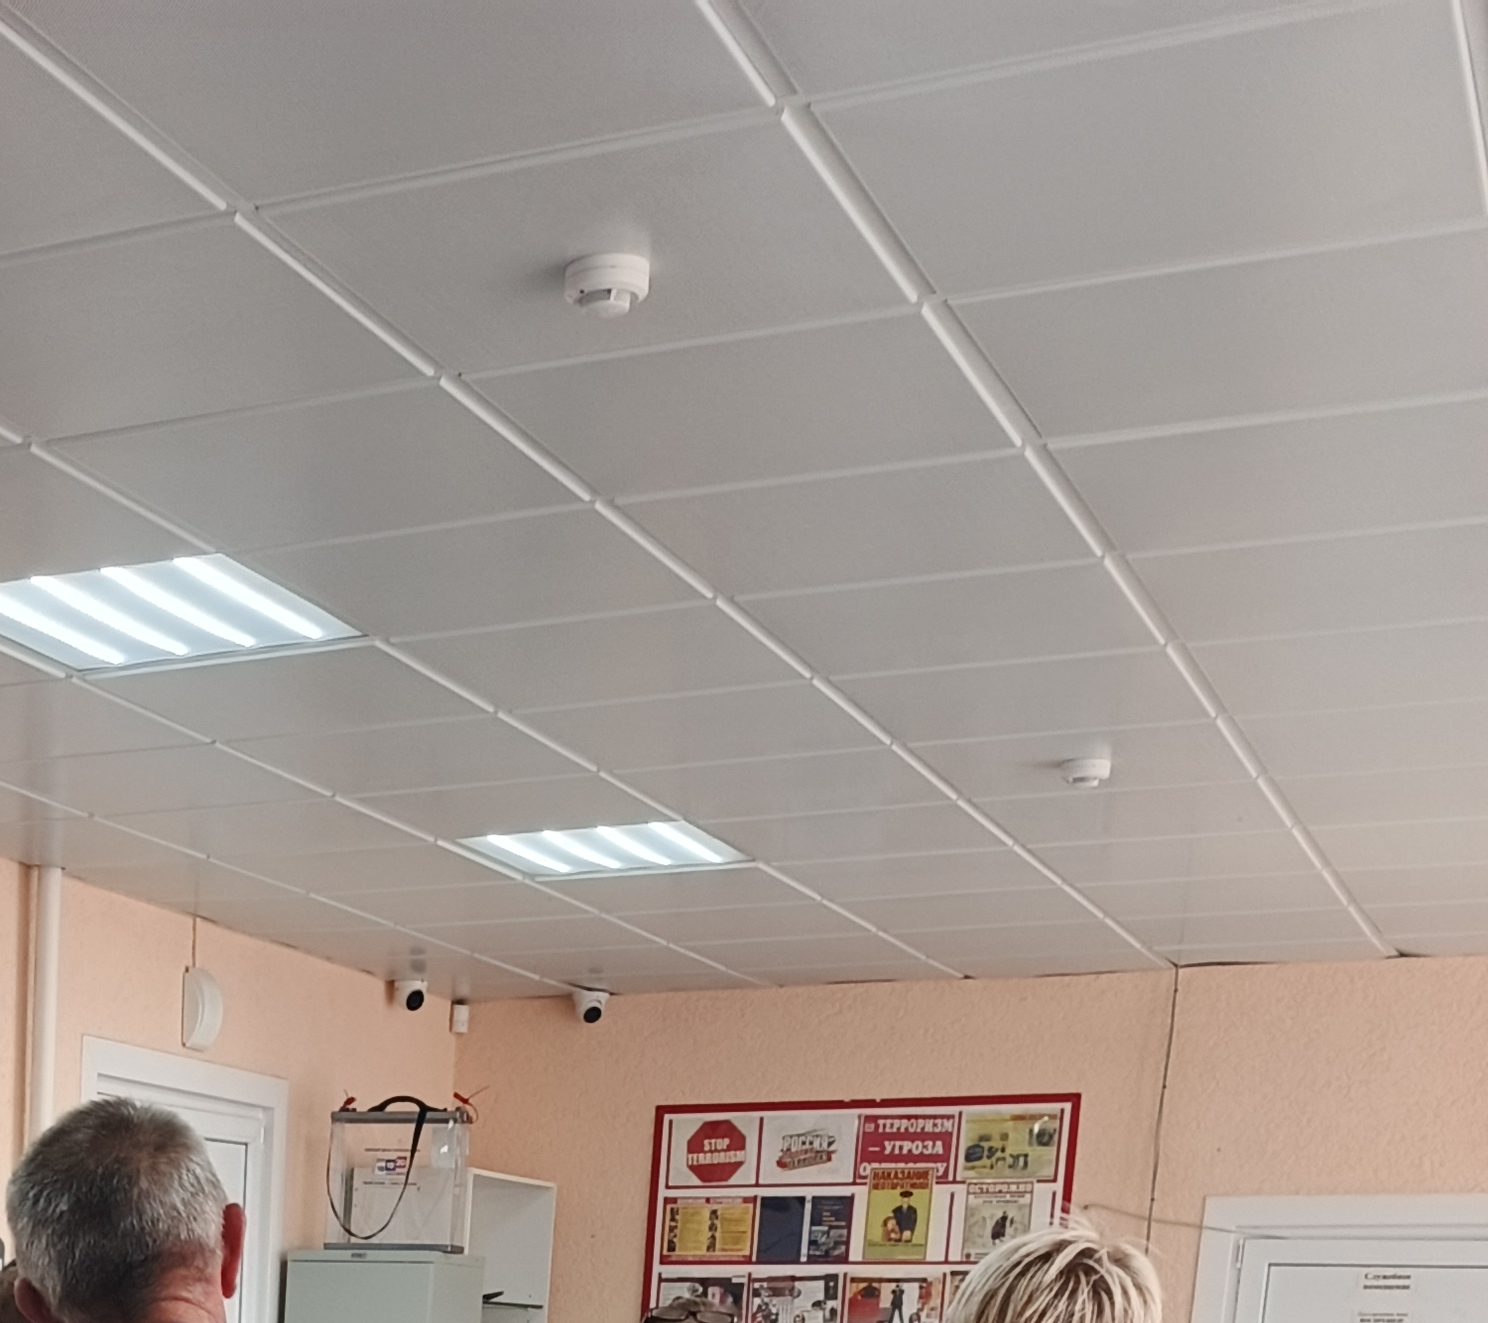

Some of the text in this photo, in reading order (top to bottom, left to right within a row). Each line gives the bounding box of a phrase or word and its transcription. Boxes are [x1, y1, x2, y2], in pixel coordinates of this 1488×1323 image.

[877, 1118, 954, 1133] ТЕРРОРИЗМ
[703, 1137, 730, 1151] STOP
[884, 1140, 944, 1155] УГРОЗА
[687, 1149, 745, 1166] TERRORISM
[872, 1169, 930, 1182] НАКАЗАНИЕ
[968, 1183, 1033, 1195] ОСТОРОЖНО
